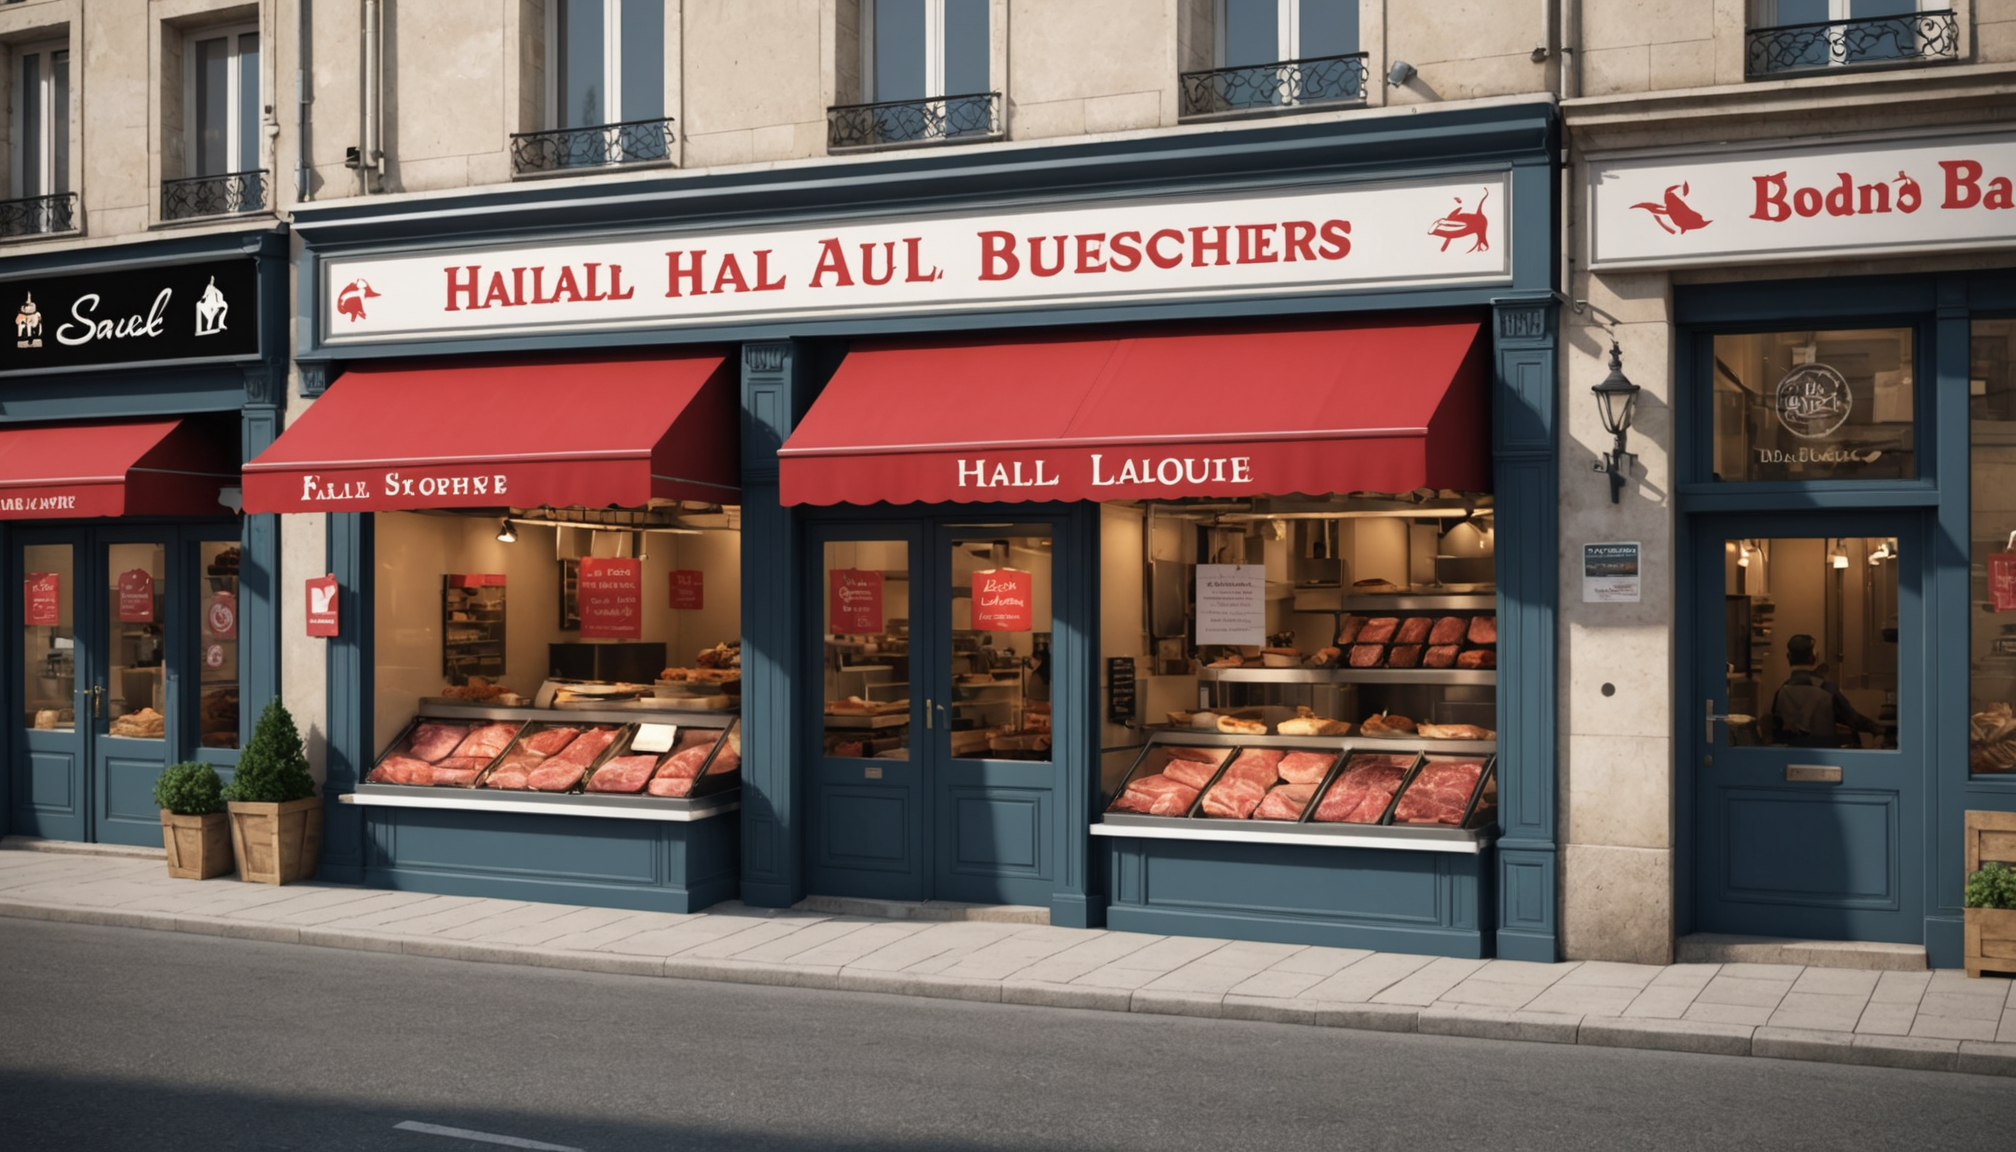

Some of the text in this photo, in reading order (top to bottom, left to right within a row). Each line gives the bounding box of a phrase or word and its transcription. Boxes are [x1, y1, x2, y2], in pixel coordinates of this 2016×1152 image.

[1938, 159, 2016, 211] Ba
[665, 249, 787, 299] HAL
[957, 459, 1060, 488] HALL
